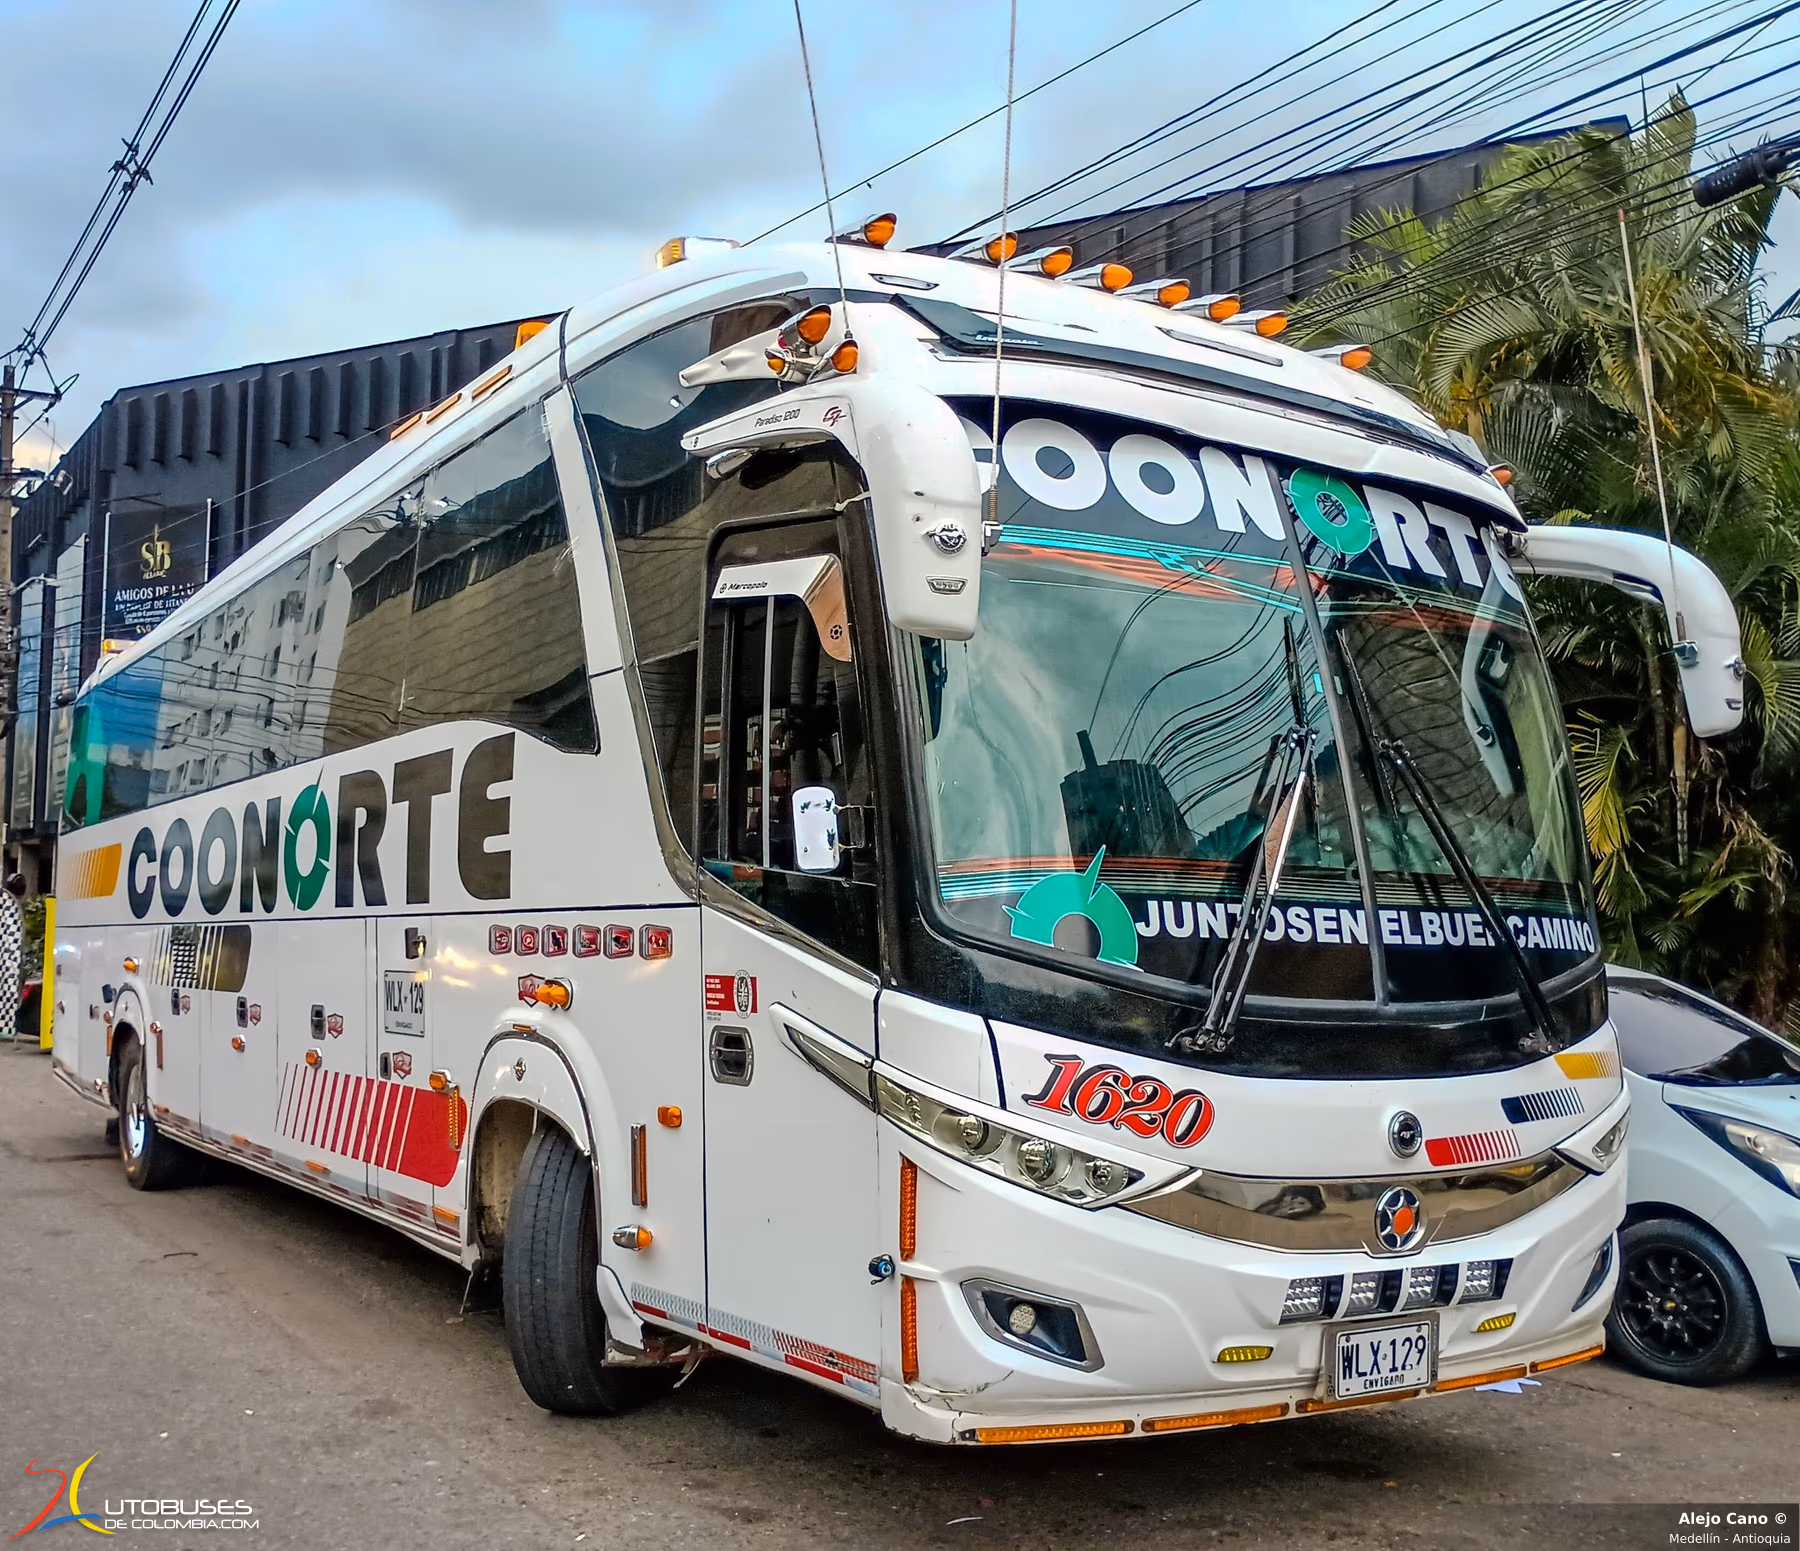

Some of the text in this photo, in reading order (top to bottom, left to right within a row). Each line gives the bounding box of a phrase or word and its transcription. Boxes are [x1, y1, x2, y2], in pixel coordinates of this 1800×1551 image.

[754, 414, 783, 428] Paradiso
[728, 581, 768, 591] Marcopolo
[114, 587, 154, 602] AMIGOS
[127, 731, 516, 919] COONORTE
[1021, 1053, 1215, 1149] 1620
